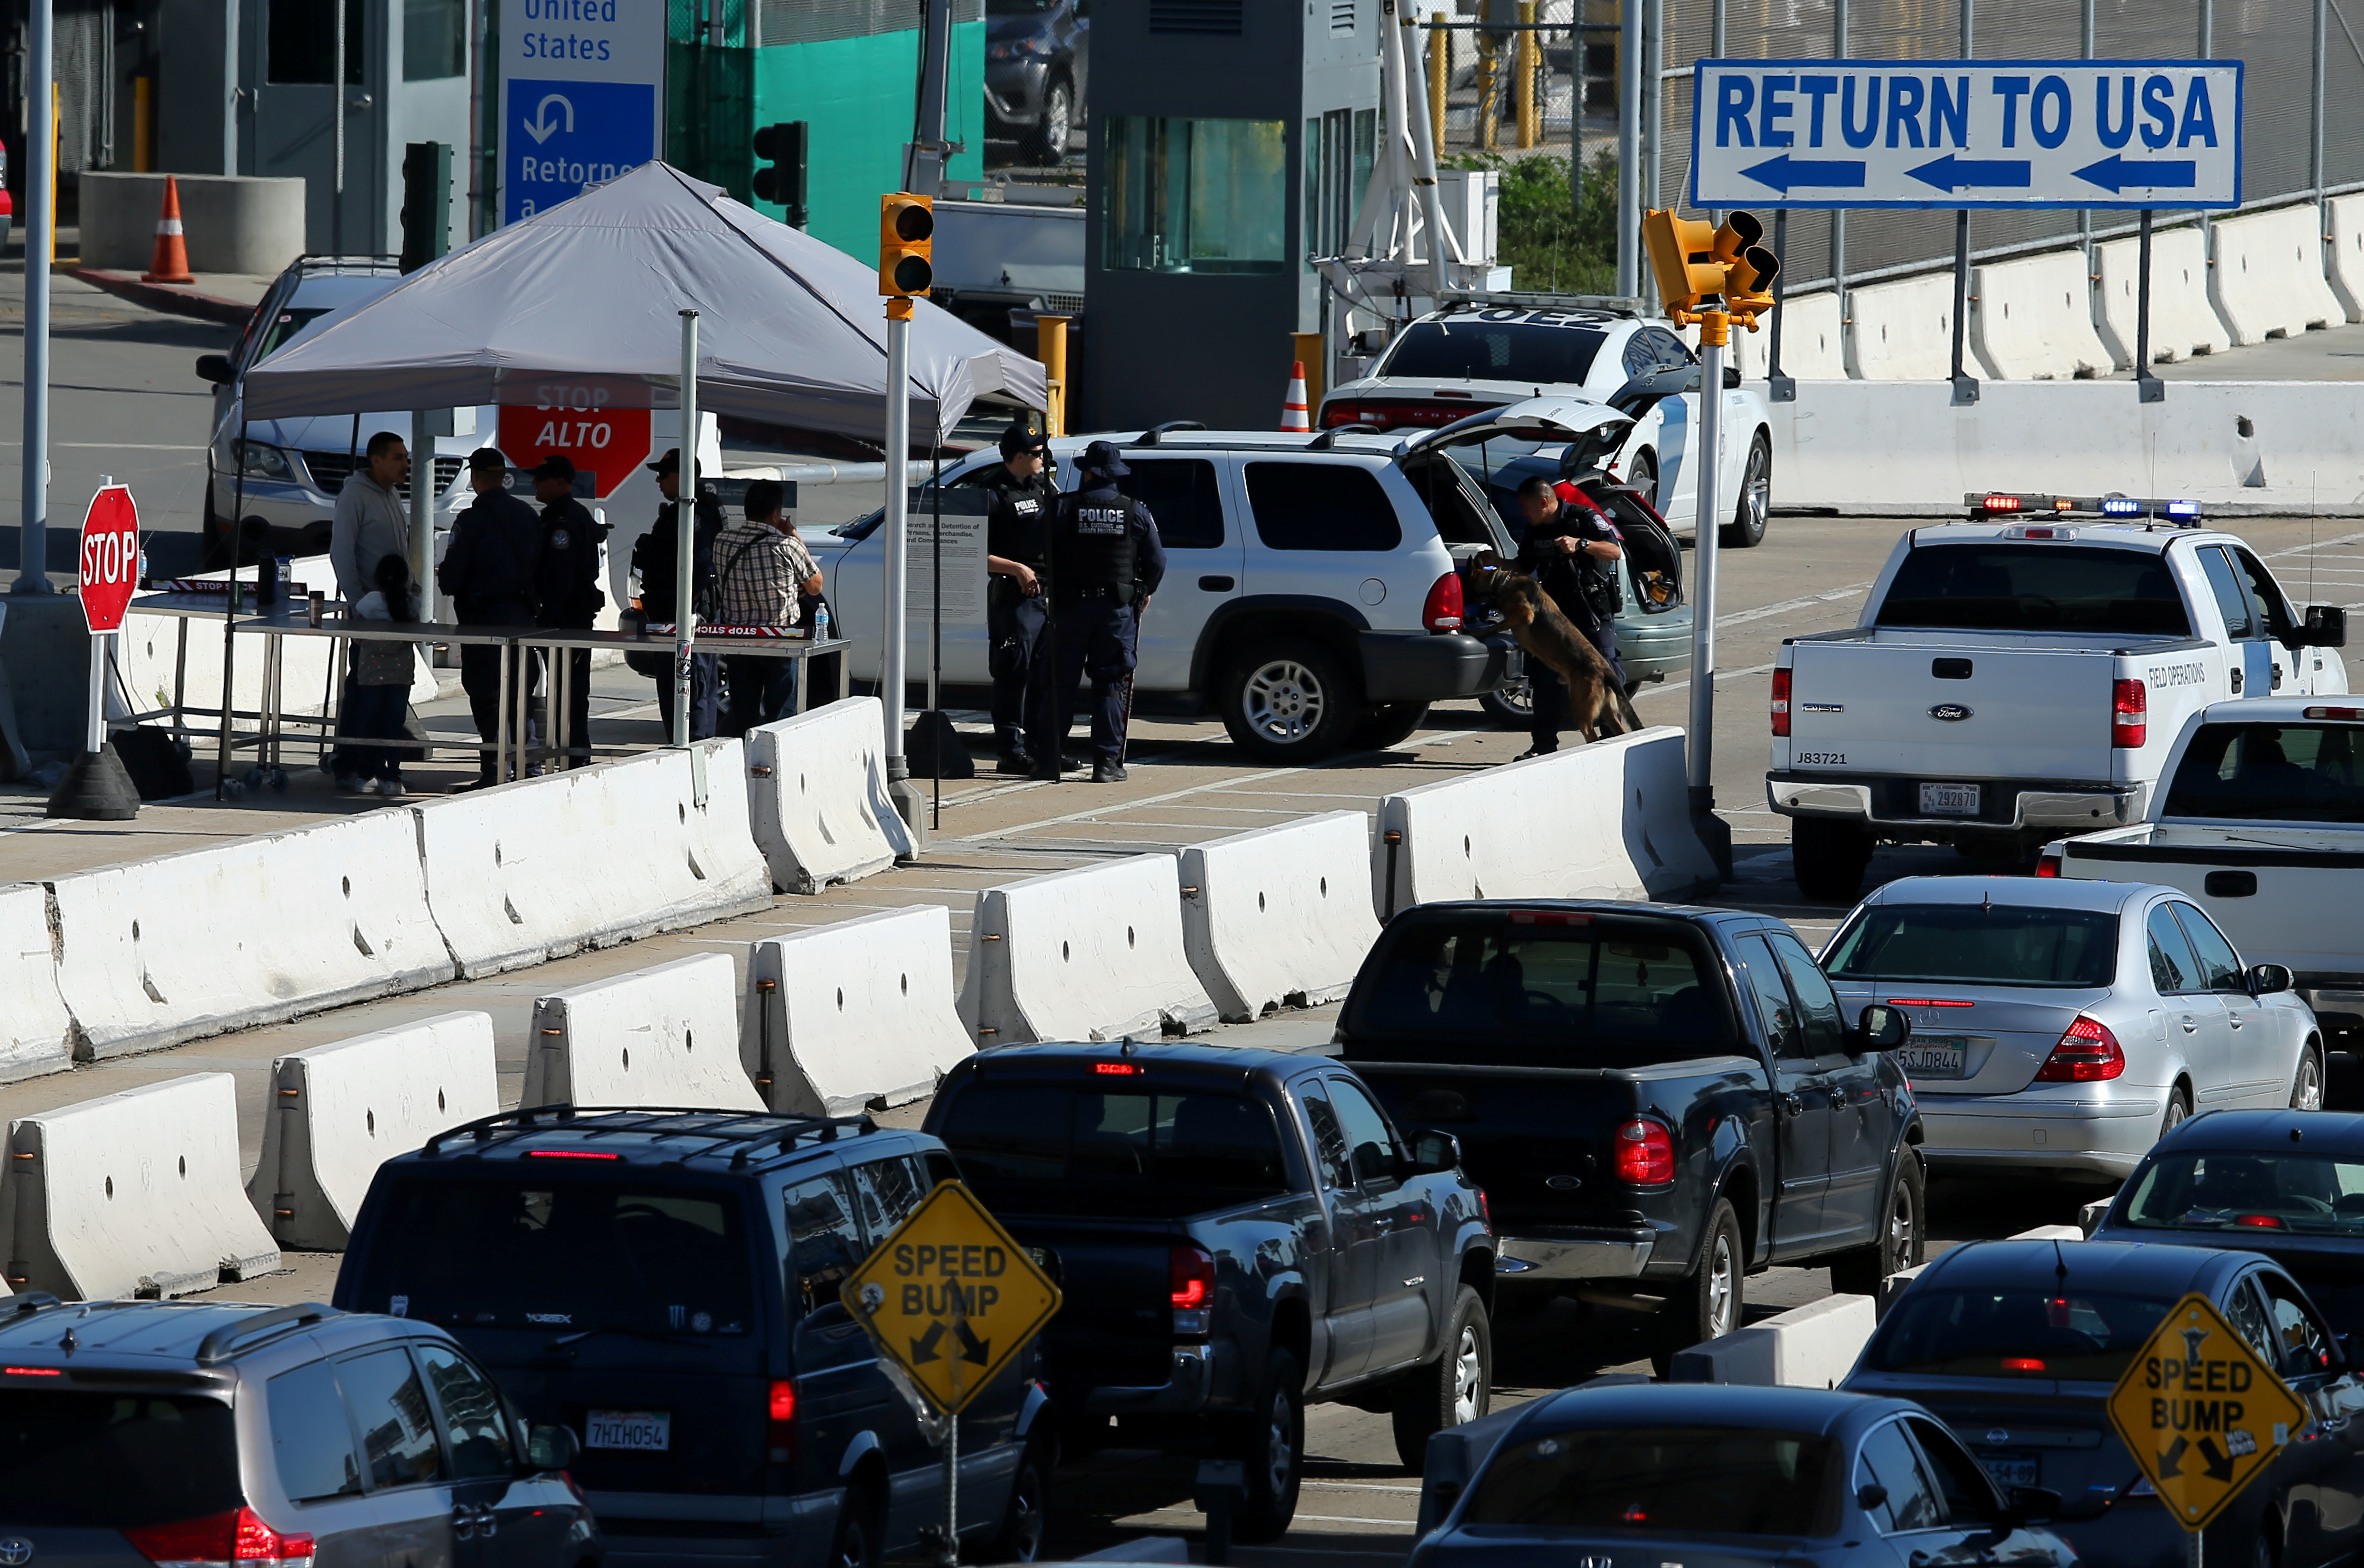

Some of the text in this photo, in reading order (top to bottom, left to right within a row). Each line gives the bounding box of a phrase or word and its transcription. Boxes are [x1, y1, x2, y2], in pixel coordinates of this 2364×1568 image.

[525, 0, 616, 22] United
[523, 33, 611, 61] States
[1715, 75, 2218, 149] RETURN TO USA
[521, 199, 536, 219] a
[537, 385, 609, 413] STOP
[535, 421, 611, 449] ALTO
[1014, 499, 1039, 511] POLICE
[1079, 508, 1124, 523] POLICE
[83, 531, 136, 586] STOP
[728, 627, 757, 635] STOP
[2148, 662, 2206, 689] FIELD OPERATIONS
[1937, 707, 1962, 718] Ford
[1797, 752, 1847, 765] J83721
[1937, 791, 1976, 807] 292870
[1898, 1050, 1959, 1068] 5SJD844
[894, 1244, 1007, 1277] SPEED
[901, 1284, 999, 1317] BUMP
[2146, 1356, 2252, 1393] SPEED
[2151, 1397, 2244, 1433] BUMP
